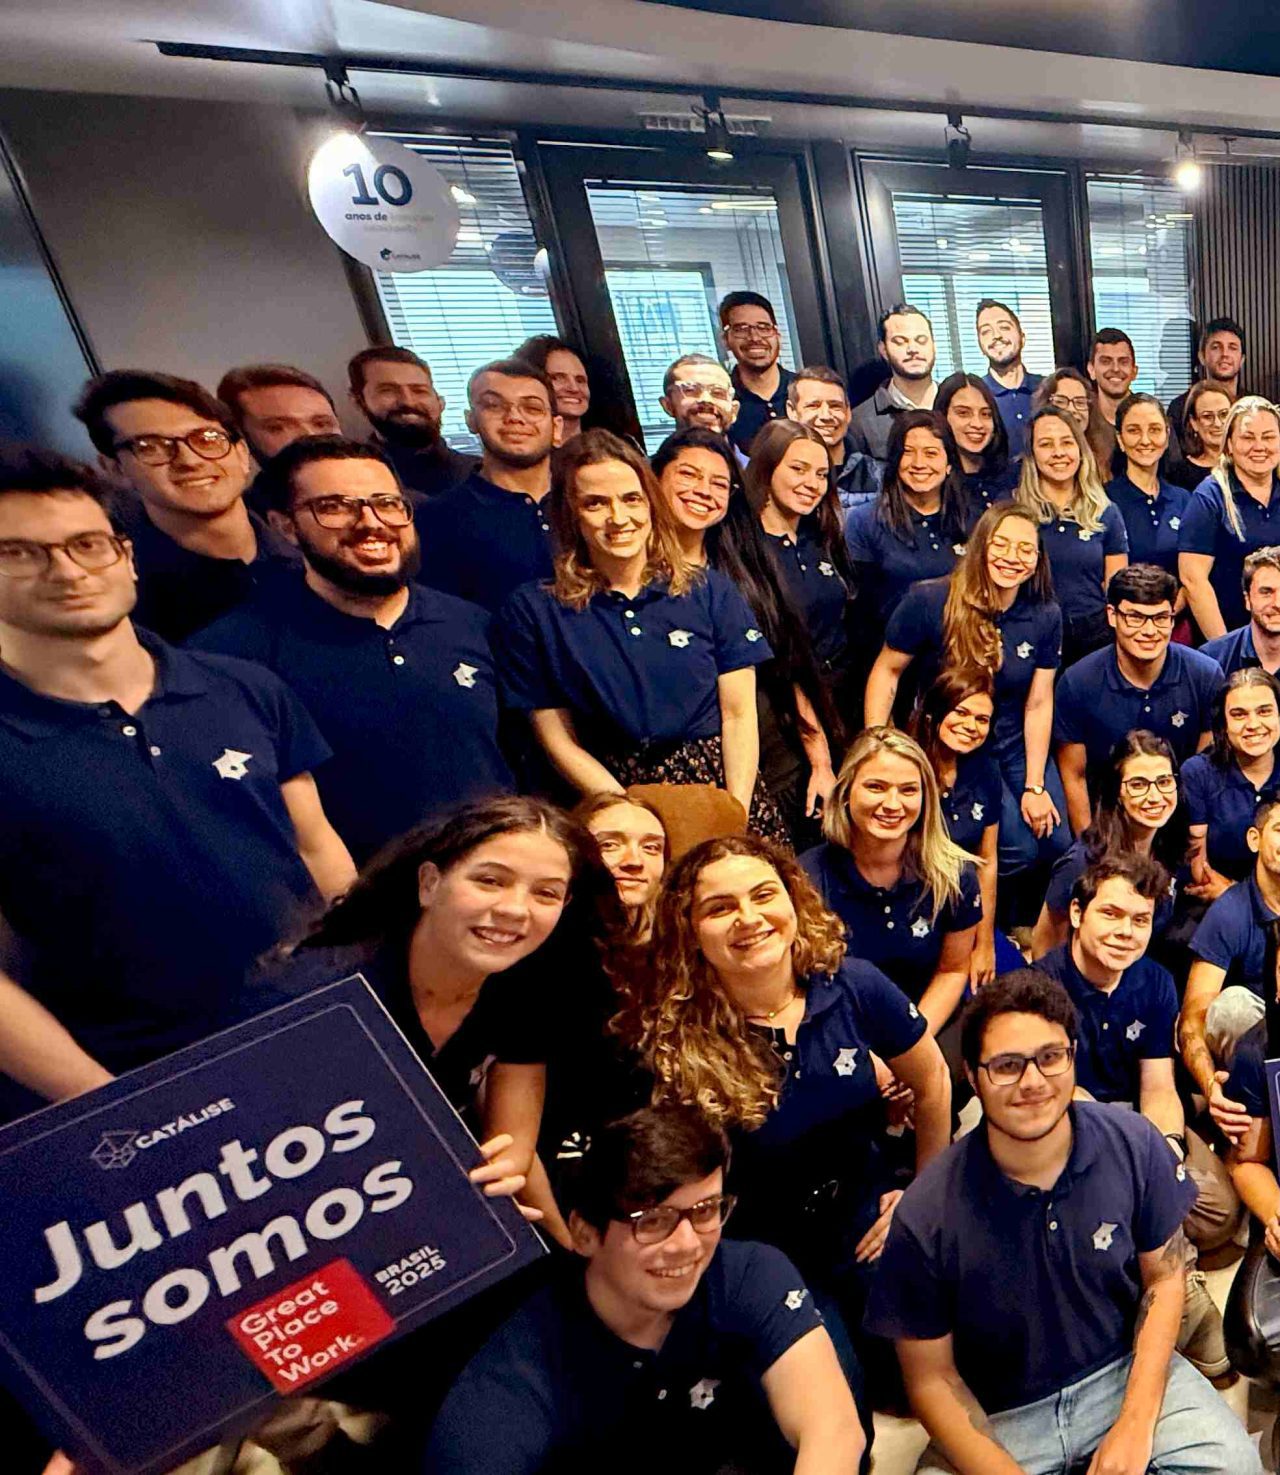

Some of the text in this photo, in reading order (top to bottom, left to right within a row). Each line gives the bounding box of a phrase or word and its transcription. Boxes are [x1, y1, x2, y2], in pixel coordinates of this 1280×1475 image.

[343, 163, 413, 207] 10
[345, 212, 372, 221] anos
[374, 211, 388, 221] de
[134, 1098, 237, 1150] CATÁLISE
[34, 1100, 377, 1304] Juntos
[83, 1161, 413, 1360] somos
[374, 1245, 440, 1284] BRASIL
[385, 1254, 447, 1296] 2025
[240, 1281, 330, 1334] Great
[253, 1300, 339, 1351] Place
[264, 1343, 303, 1366] To
